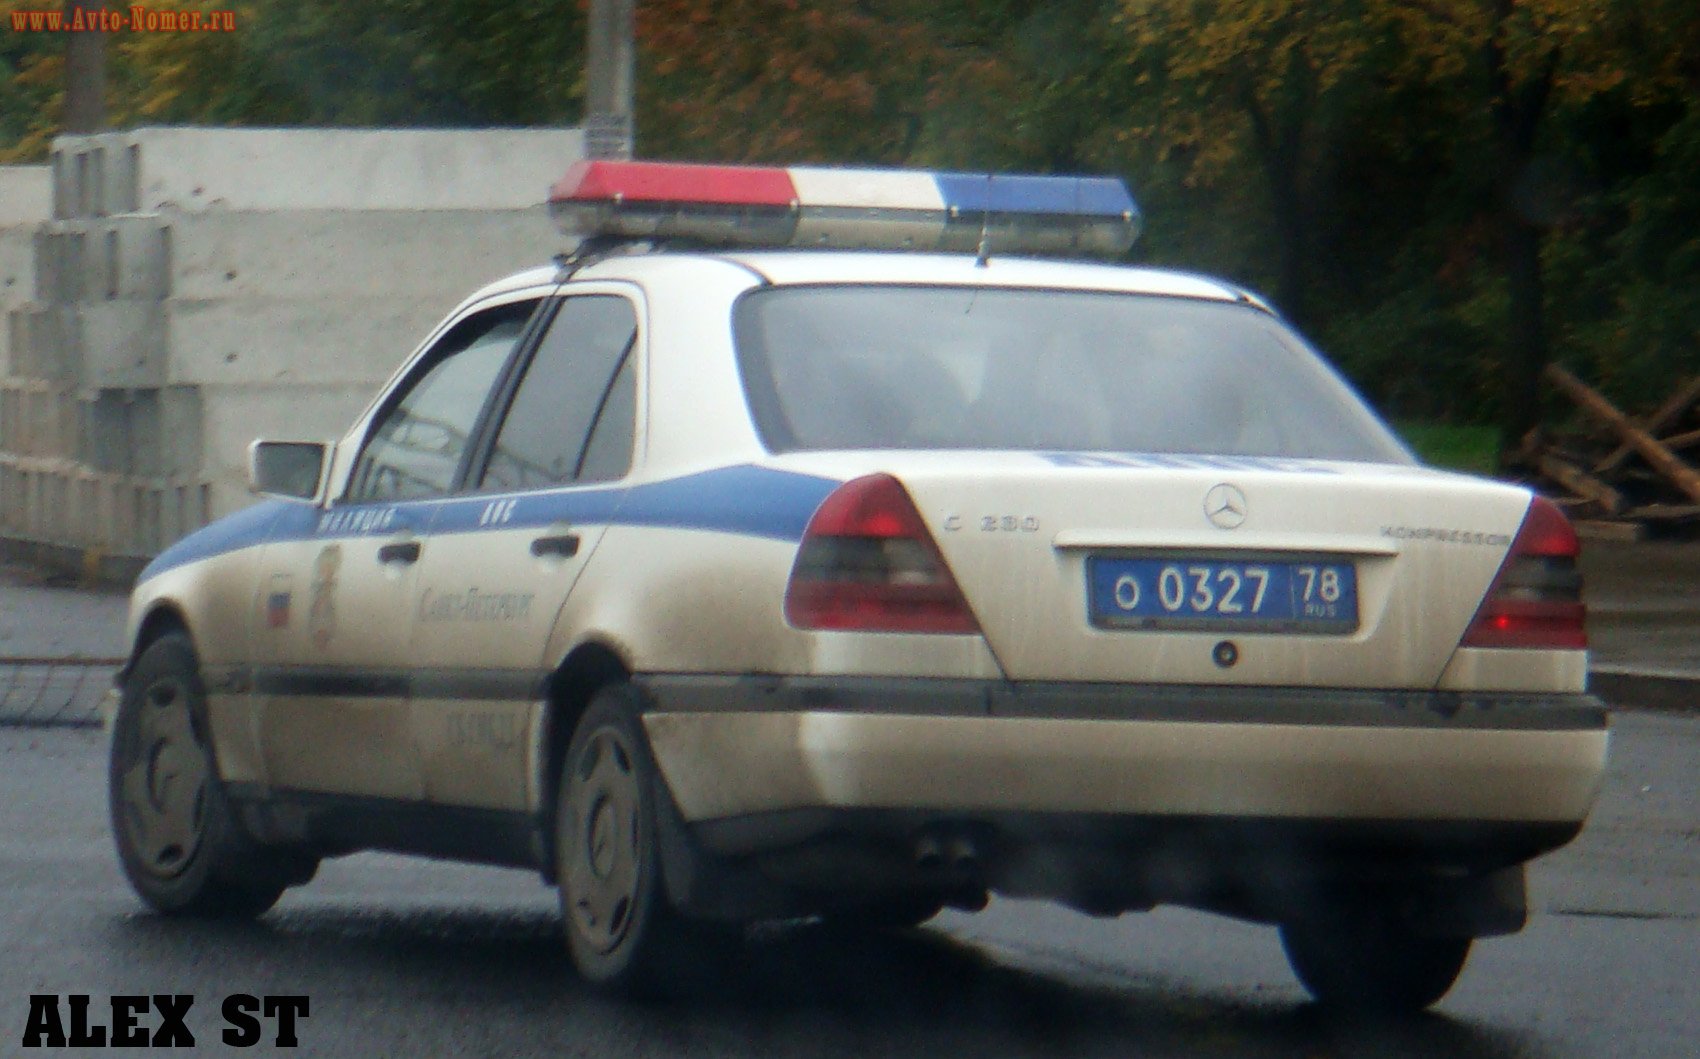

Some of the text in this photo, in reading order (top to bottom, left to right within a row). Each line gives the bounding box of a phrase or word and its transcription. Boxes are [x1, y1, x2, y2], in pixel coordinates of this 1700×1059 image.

[943, 514, 963, 532] C
[1379, 525, 1511, 546] KOMPRESSOR
[1158, 565, 1269, 614] 0327
[1299, 567, 1341, 603] 78
[1303, 602, 1338, 618] RUS
